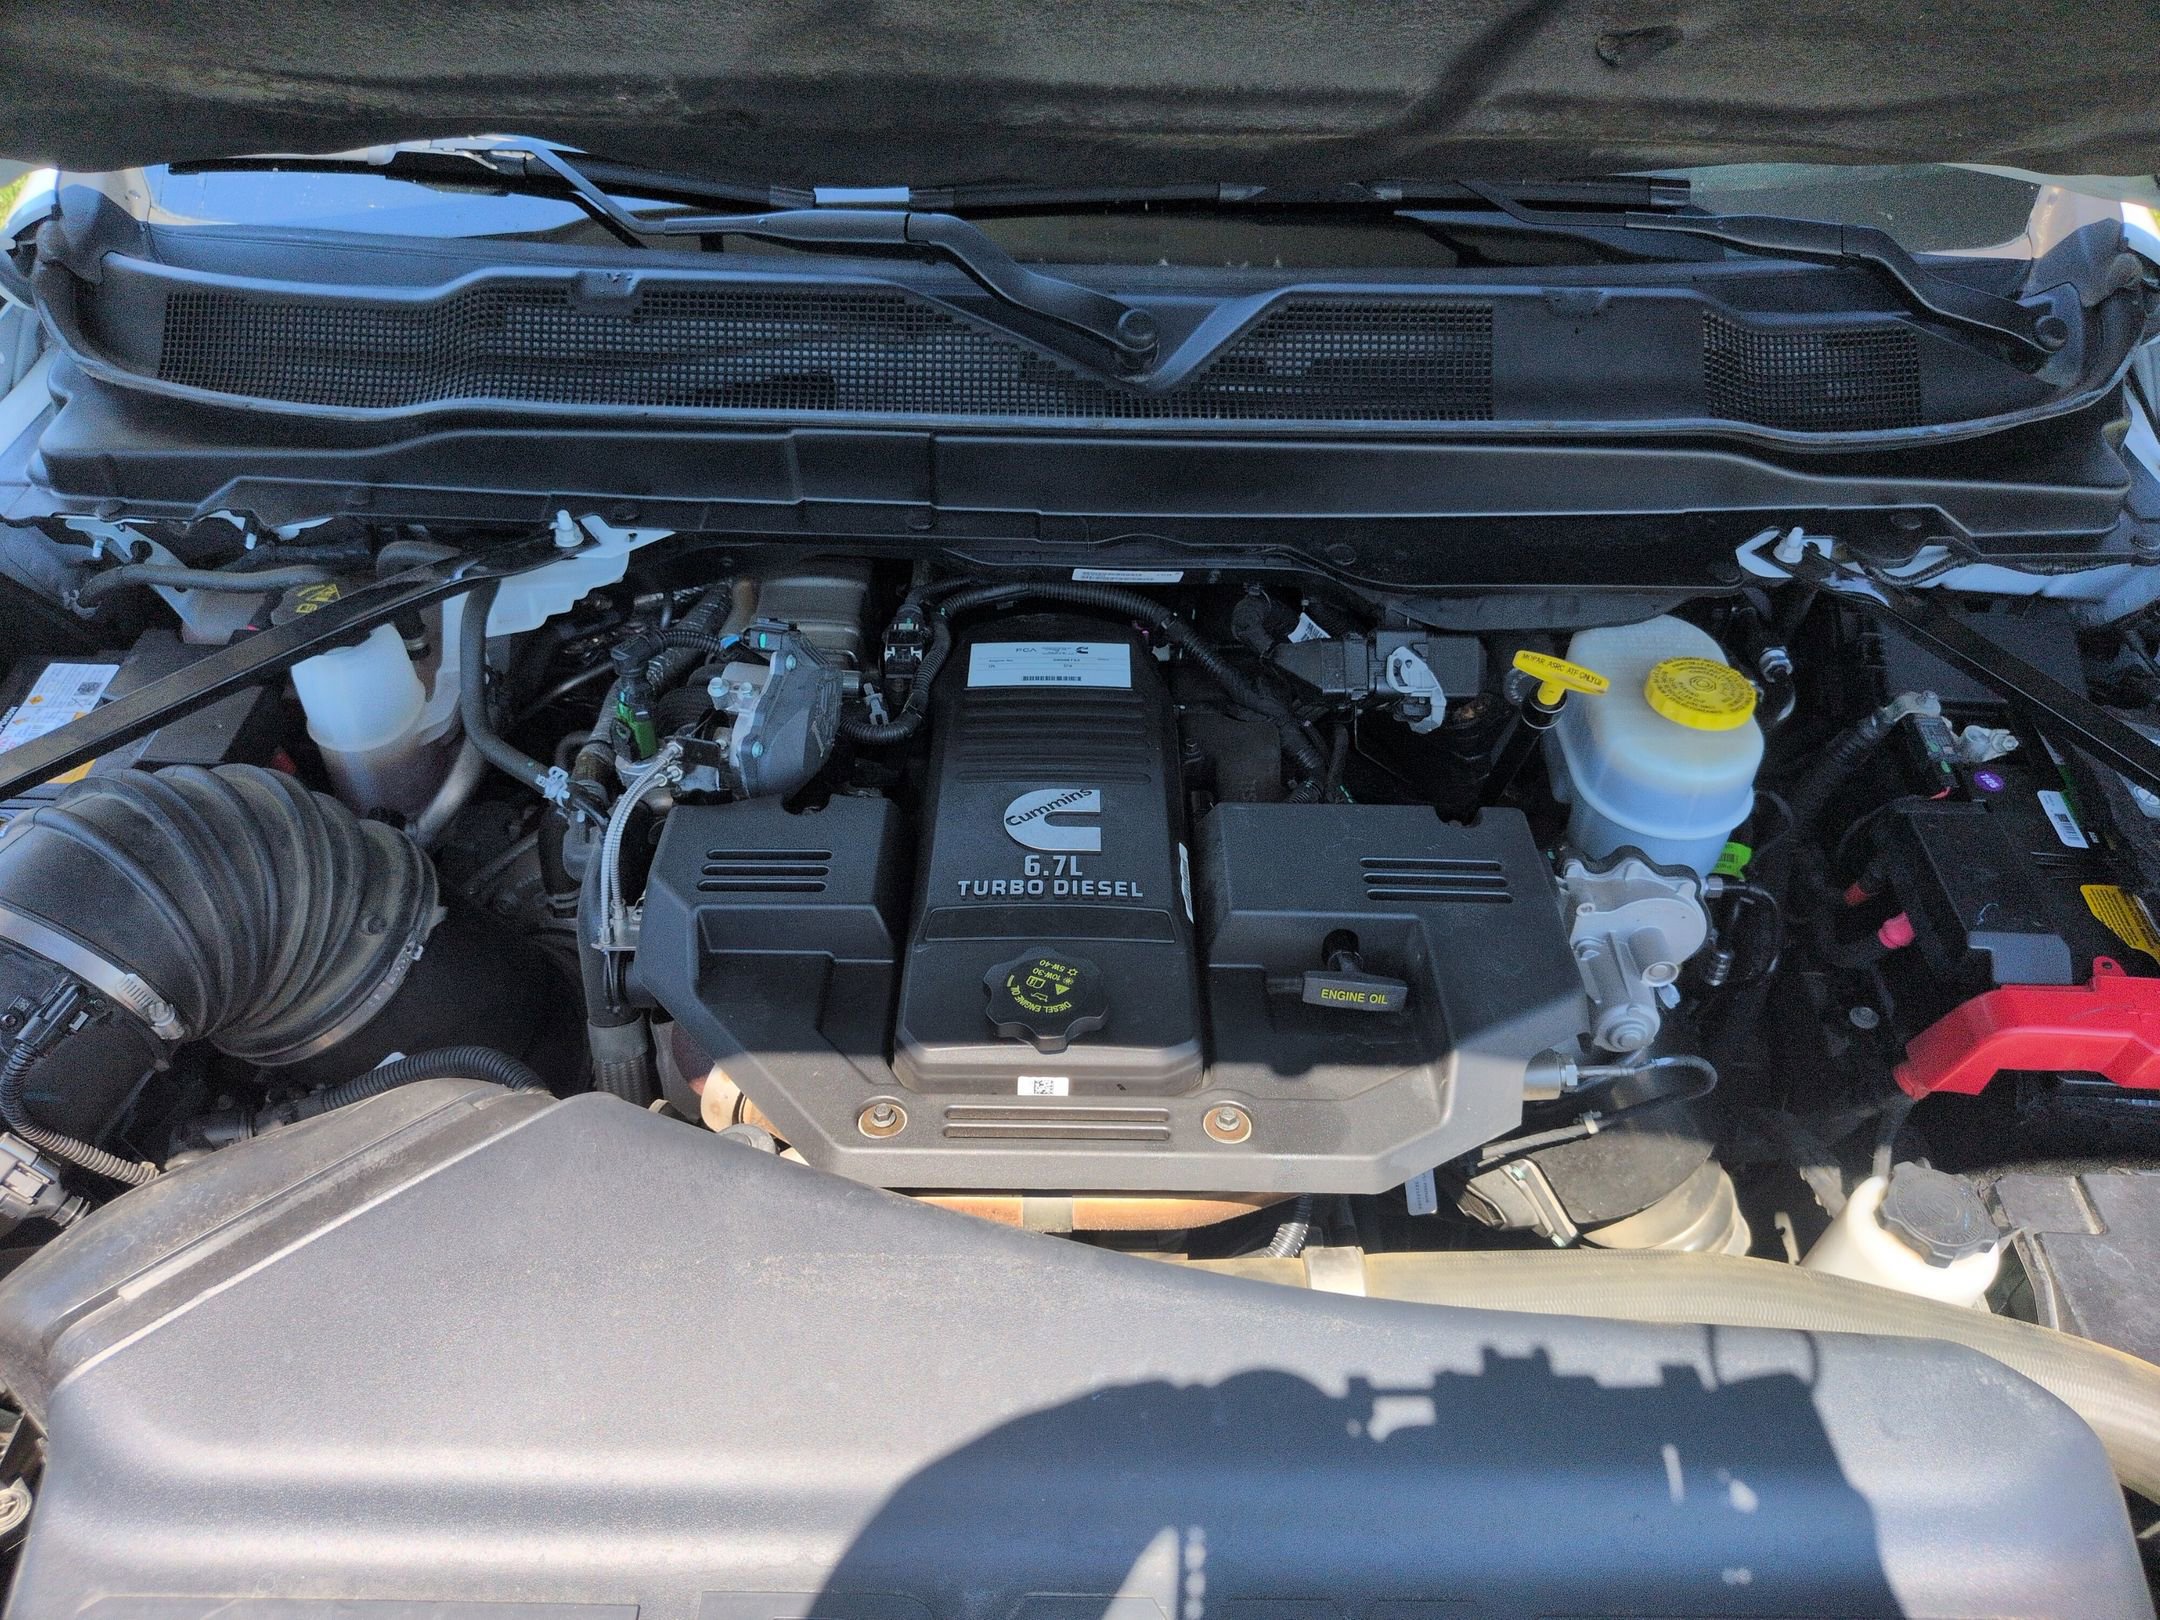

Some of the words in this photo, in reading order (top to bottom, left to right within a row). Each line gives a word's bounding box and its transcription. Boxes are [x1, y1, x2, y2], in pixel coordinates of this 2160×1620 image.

[1522, 653, 1545, 665] MOPAR
[1547, 660, 1565, 672] ASRC
[1567, 667, 1580, 676] ATF
[1579, 671, 1595, 684] ONLY
[1005, 788, 1093, 826] Cummins
[1024, 855, 1083, 877] 6.7L
[958, 880, 1044, 897] TURBO
[1053, 880, 1144, 898] DIESEL
[1032, 967, 1061, 981] 10W-30
[1039, 959, 1066, 973] 5W-40
[1010, 985, 1021, 997] OIL
[1320, 988, 1365, 1002] ENGINE
[1369, 993, 1388, 1004] OIL
[1014, 995, 1042, 1013] ENGINE
[1042, 1001, 1072, 1014] DIESEL
